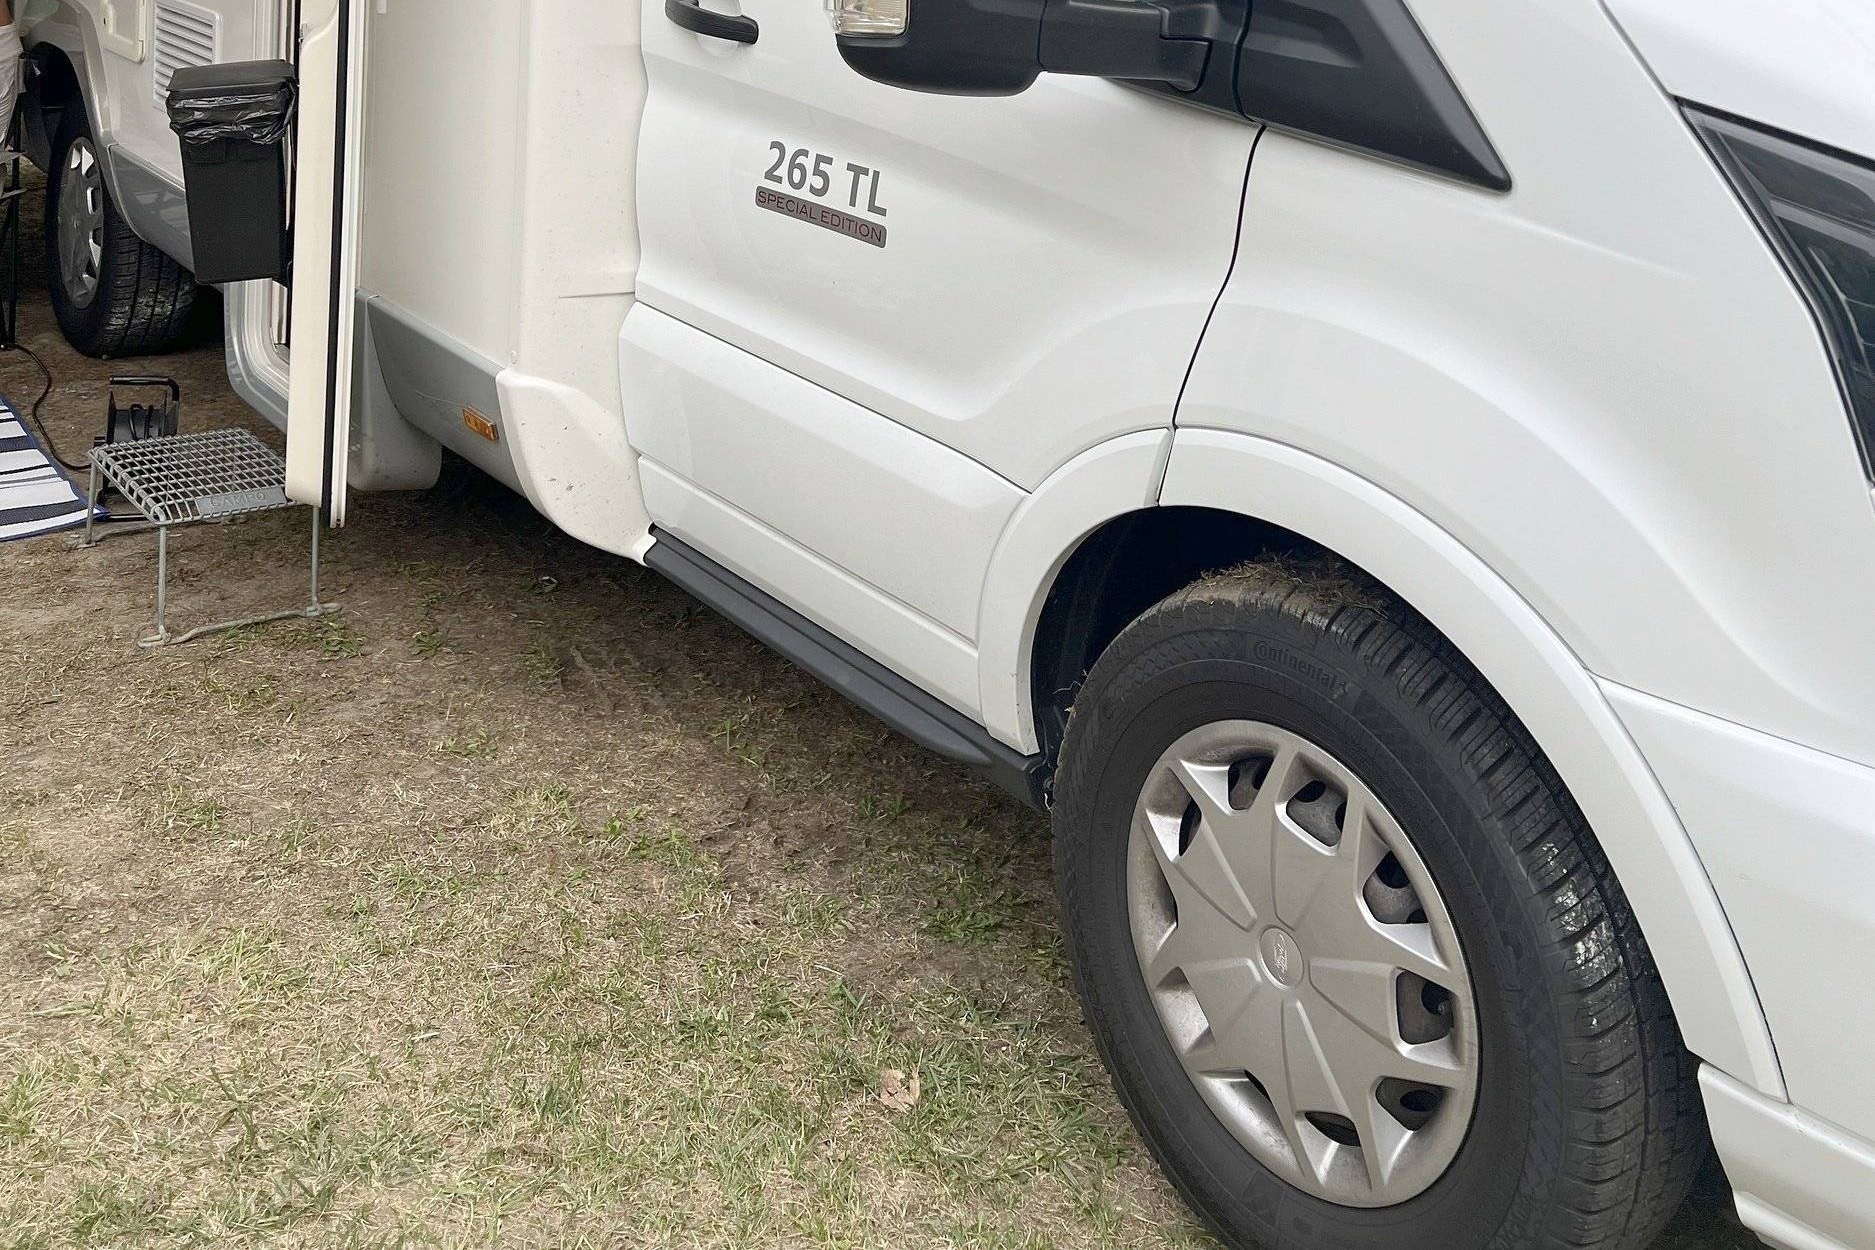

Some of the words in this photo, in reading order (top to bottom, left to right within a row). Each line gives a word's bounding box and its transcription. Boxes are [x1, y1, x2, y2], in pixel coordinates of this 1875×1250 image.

[764, 141, 833, 197] 265
[846, 162, 887, 217] TL
[757, 191, 817, 221] SPECIAL
[820, 210, 882, 242] EDITION
[1253, 640, 1338, 688] Continental
